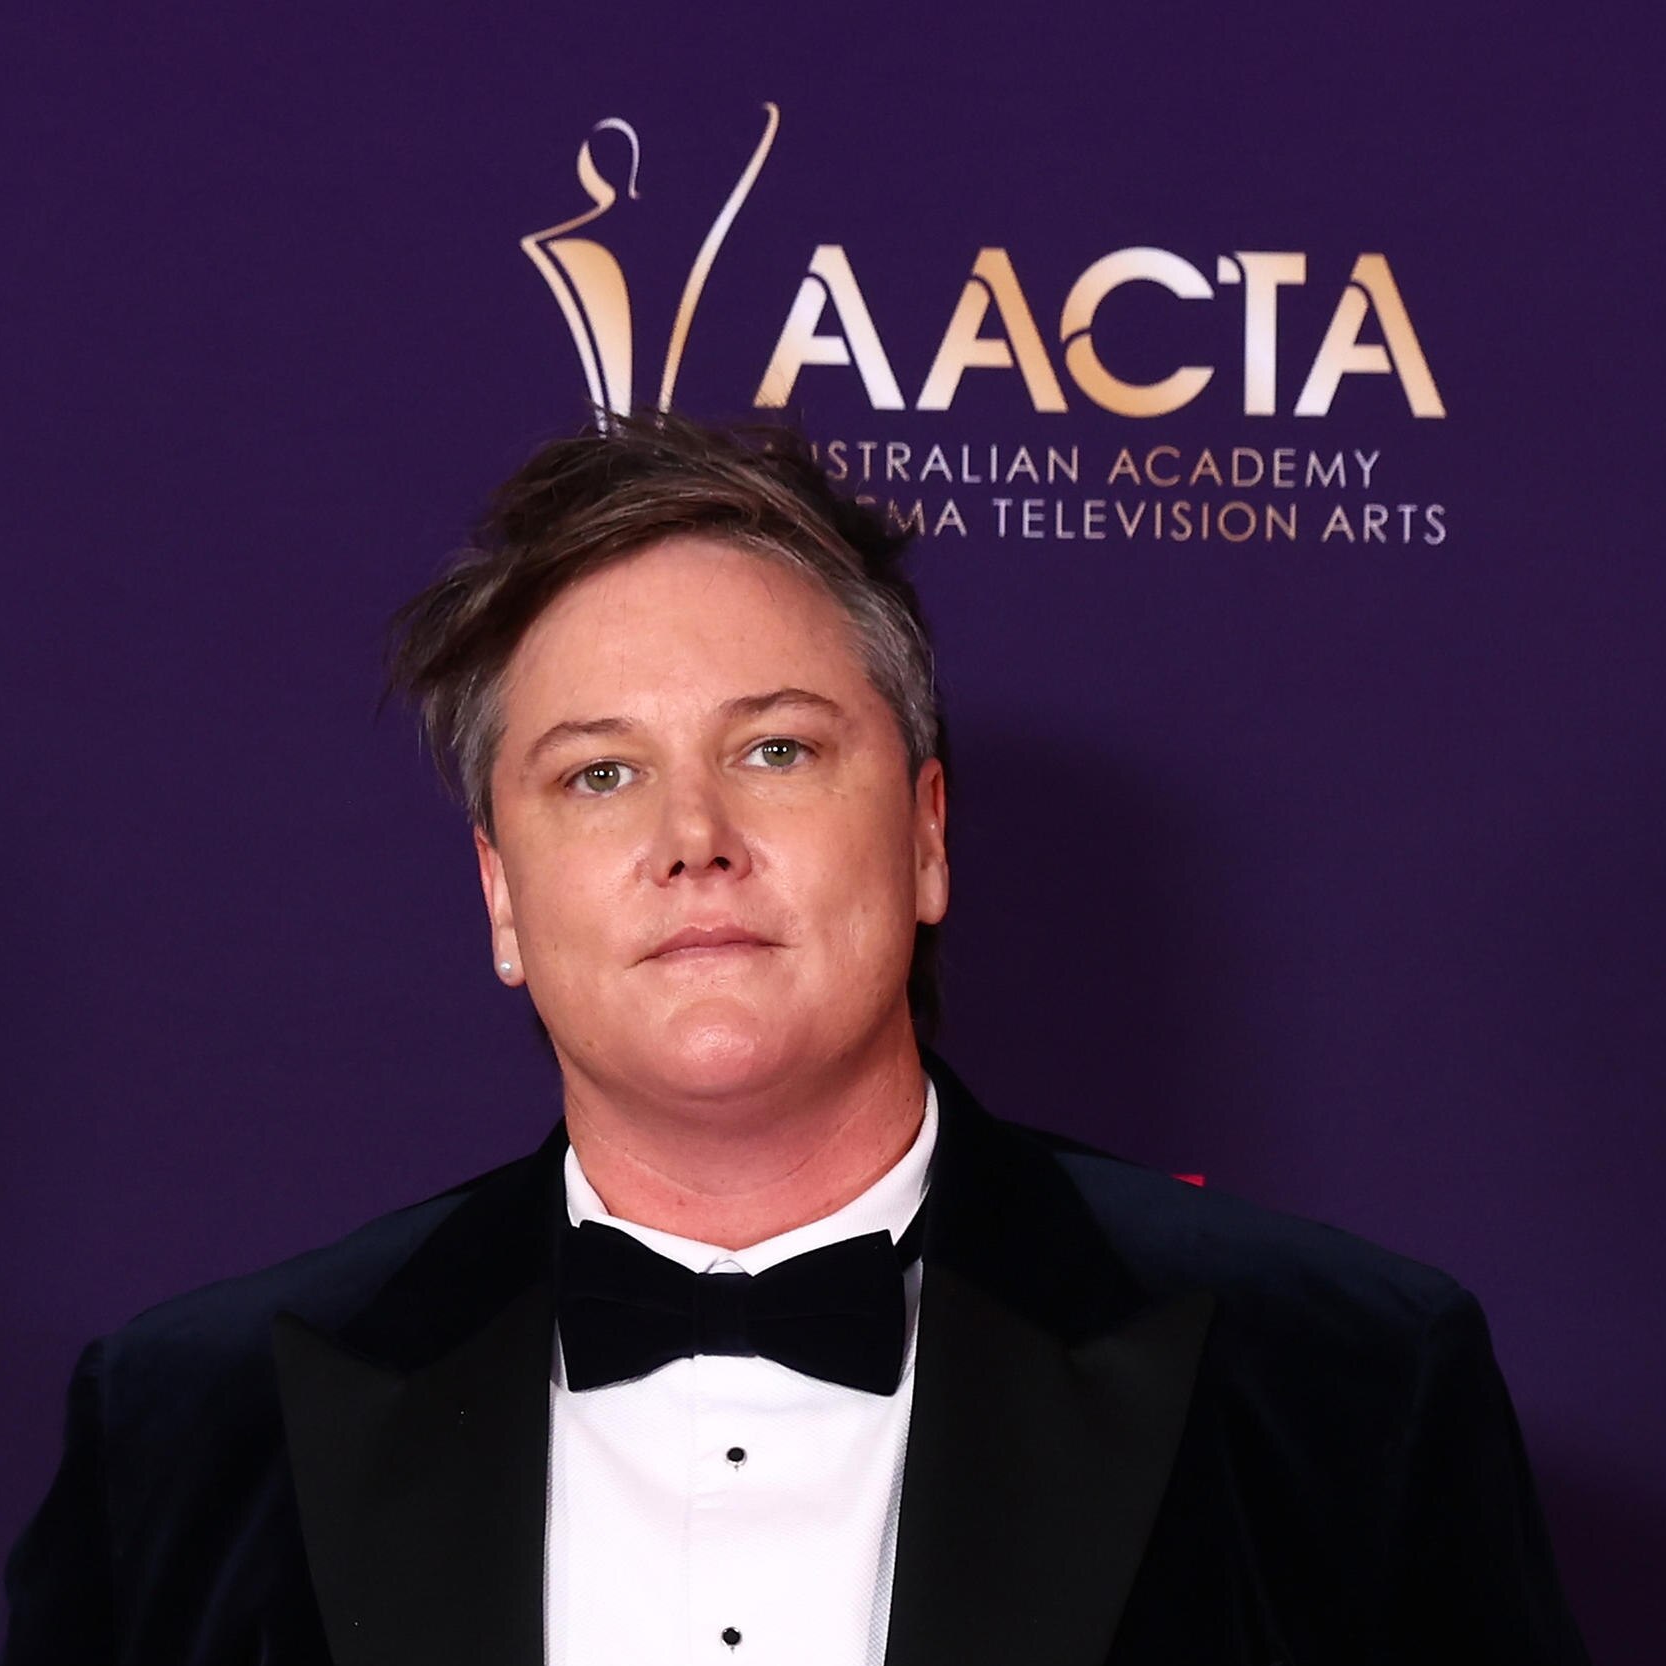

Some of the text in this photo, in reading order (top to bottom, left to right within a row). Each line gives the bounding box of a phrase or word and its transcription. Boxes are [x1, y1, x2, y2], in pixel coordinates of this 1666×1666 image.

[753, 243, 1447, 419] AACTA
[765, 440, 1381, 490] STRALIAN ACADEMY
[991, 496, 1298, 543] TELEVISION
[1321, 502, 1447, 546] ARTS
